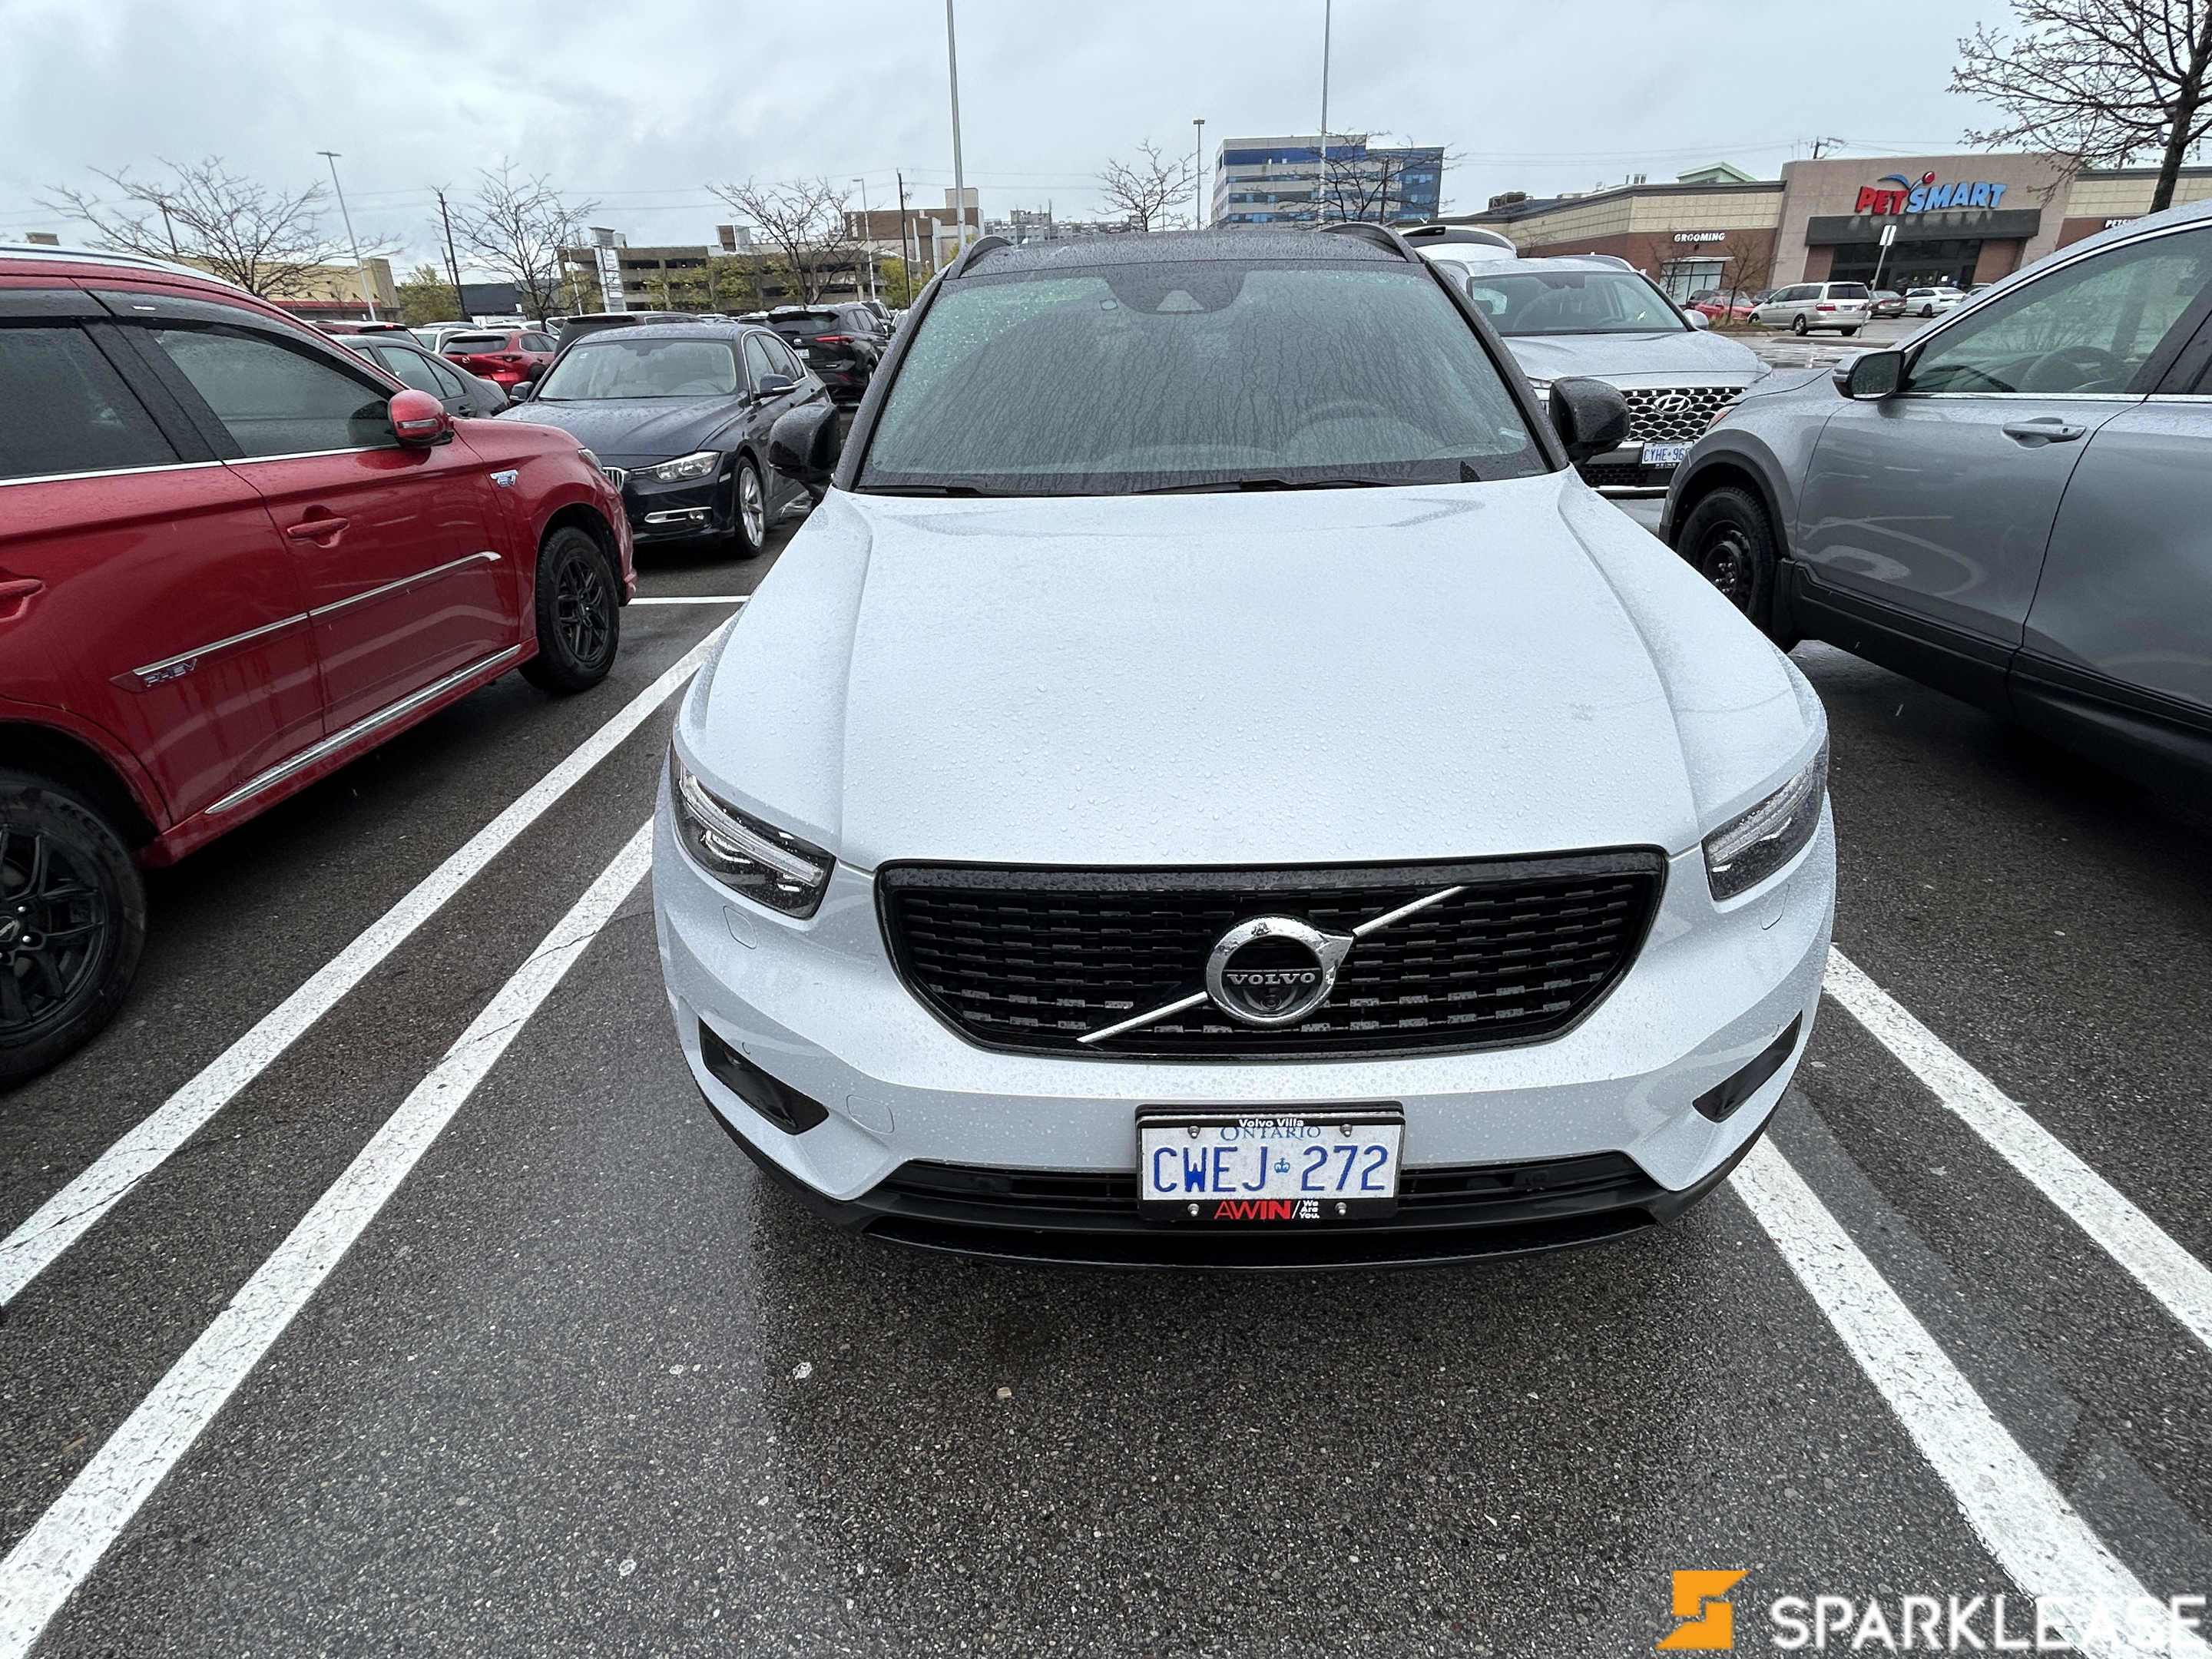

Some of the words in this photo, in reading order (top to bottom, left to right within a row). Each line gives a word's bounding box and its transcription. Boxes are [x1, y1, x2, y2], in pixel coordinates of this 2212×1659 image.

[1855, 180, 2007, 215] PETSMART
[1674, 233, 1726, 242] GROOMING
[1644, 448, 1667, 462] CYHE
[1227, 972, 1316, 985] VOLVO
[1238, 1118, 1274, 1127] Volvo
[1277, 1118, 1304, 1127] Villa
[1220, 1126, 1321, 1141] ONTARIO
[1154, 1146, 1268, 1193] CWEJ
[1300, 1144, 1389, 1191] 272
